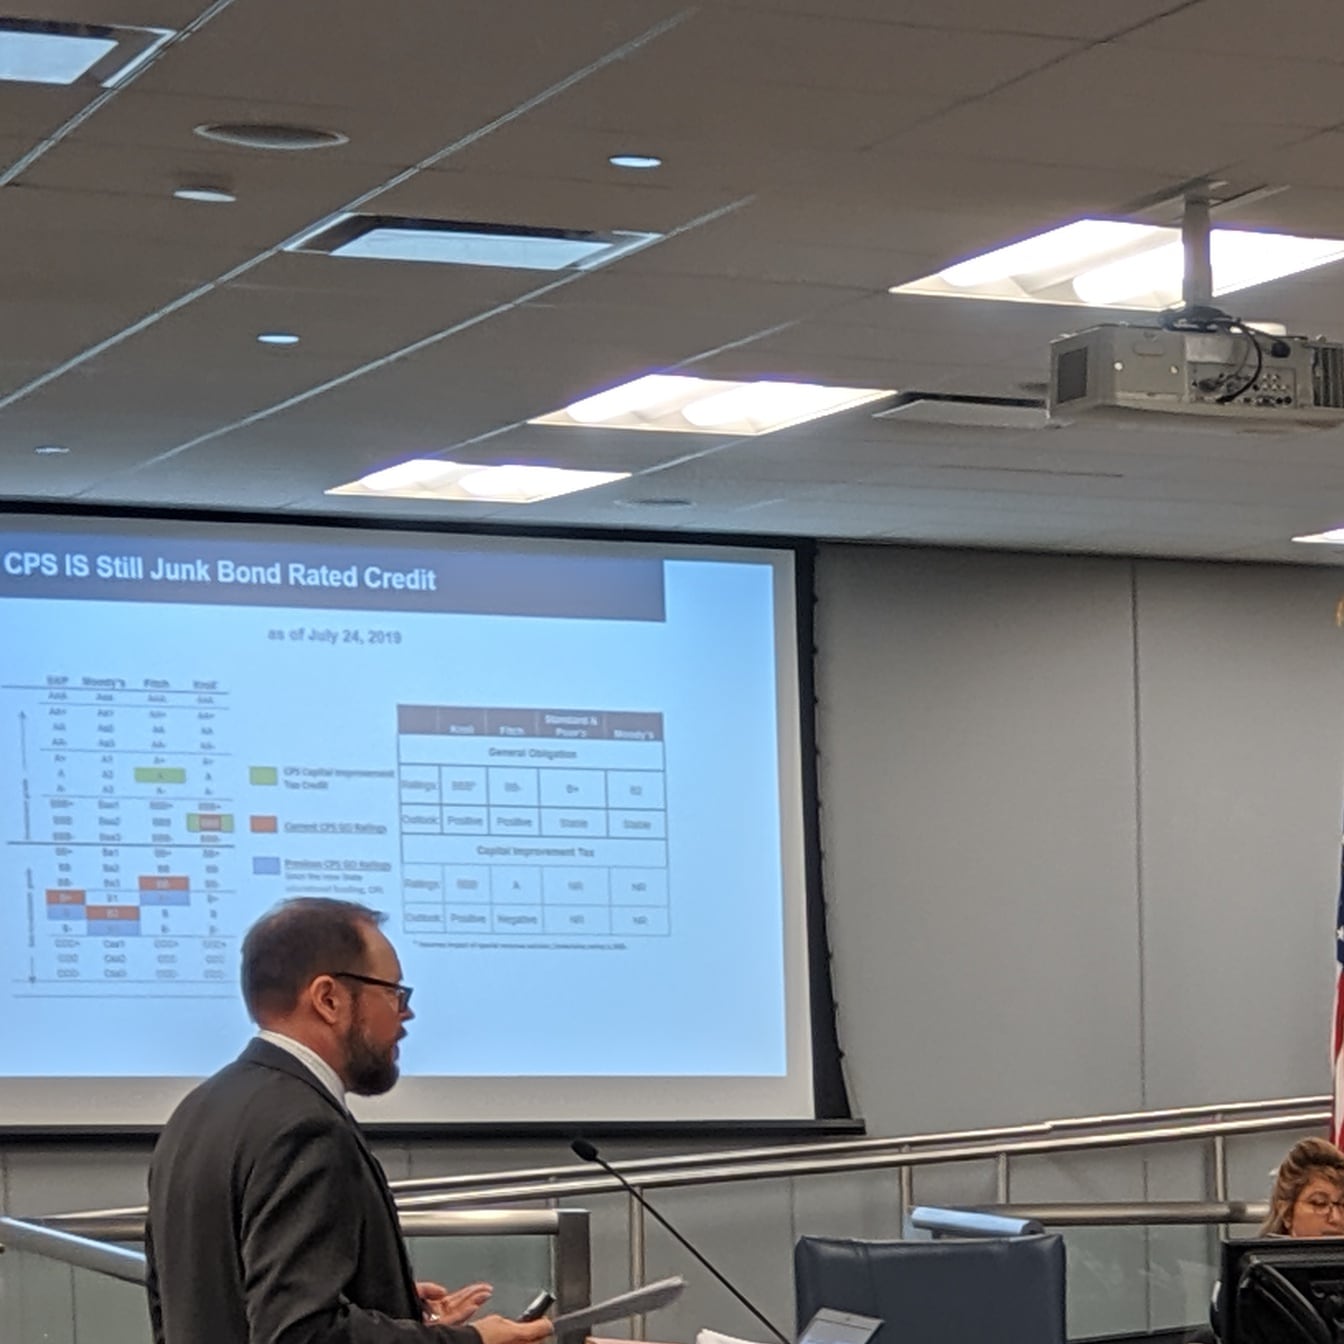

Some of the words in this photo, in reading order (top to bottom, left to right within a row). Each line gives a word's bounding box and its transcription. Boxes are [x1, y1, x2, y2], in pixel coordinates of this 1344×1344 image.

[3, 552, 58, 576] CPS
[64, 555, 89, 577] IS
[96, 556, 144, 580] Still
[150, 559, 210, 582] Junk
[217, 561, 281, 585] Bond
[288, 564, 358, 588] Rated
[364, 567, 437, 591] Credit
[267, 629, 285, 641] as
[289, 627, 305, 642] of
[308, 628, 338, 645] July
[342, 629, 364, 645] 24,
[367, 630, 402, 645] 2019
